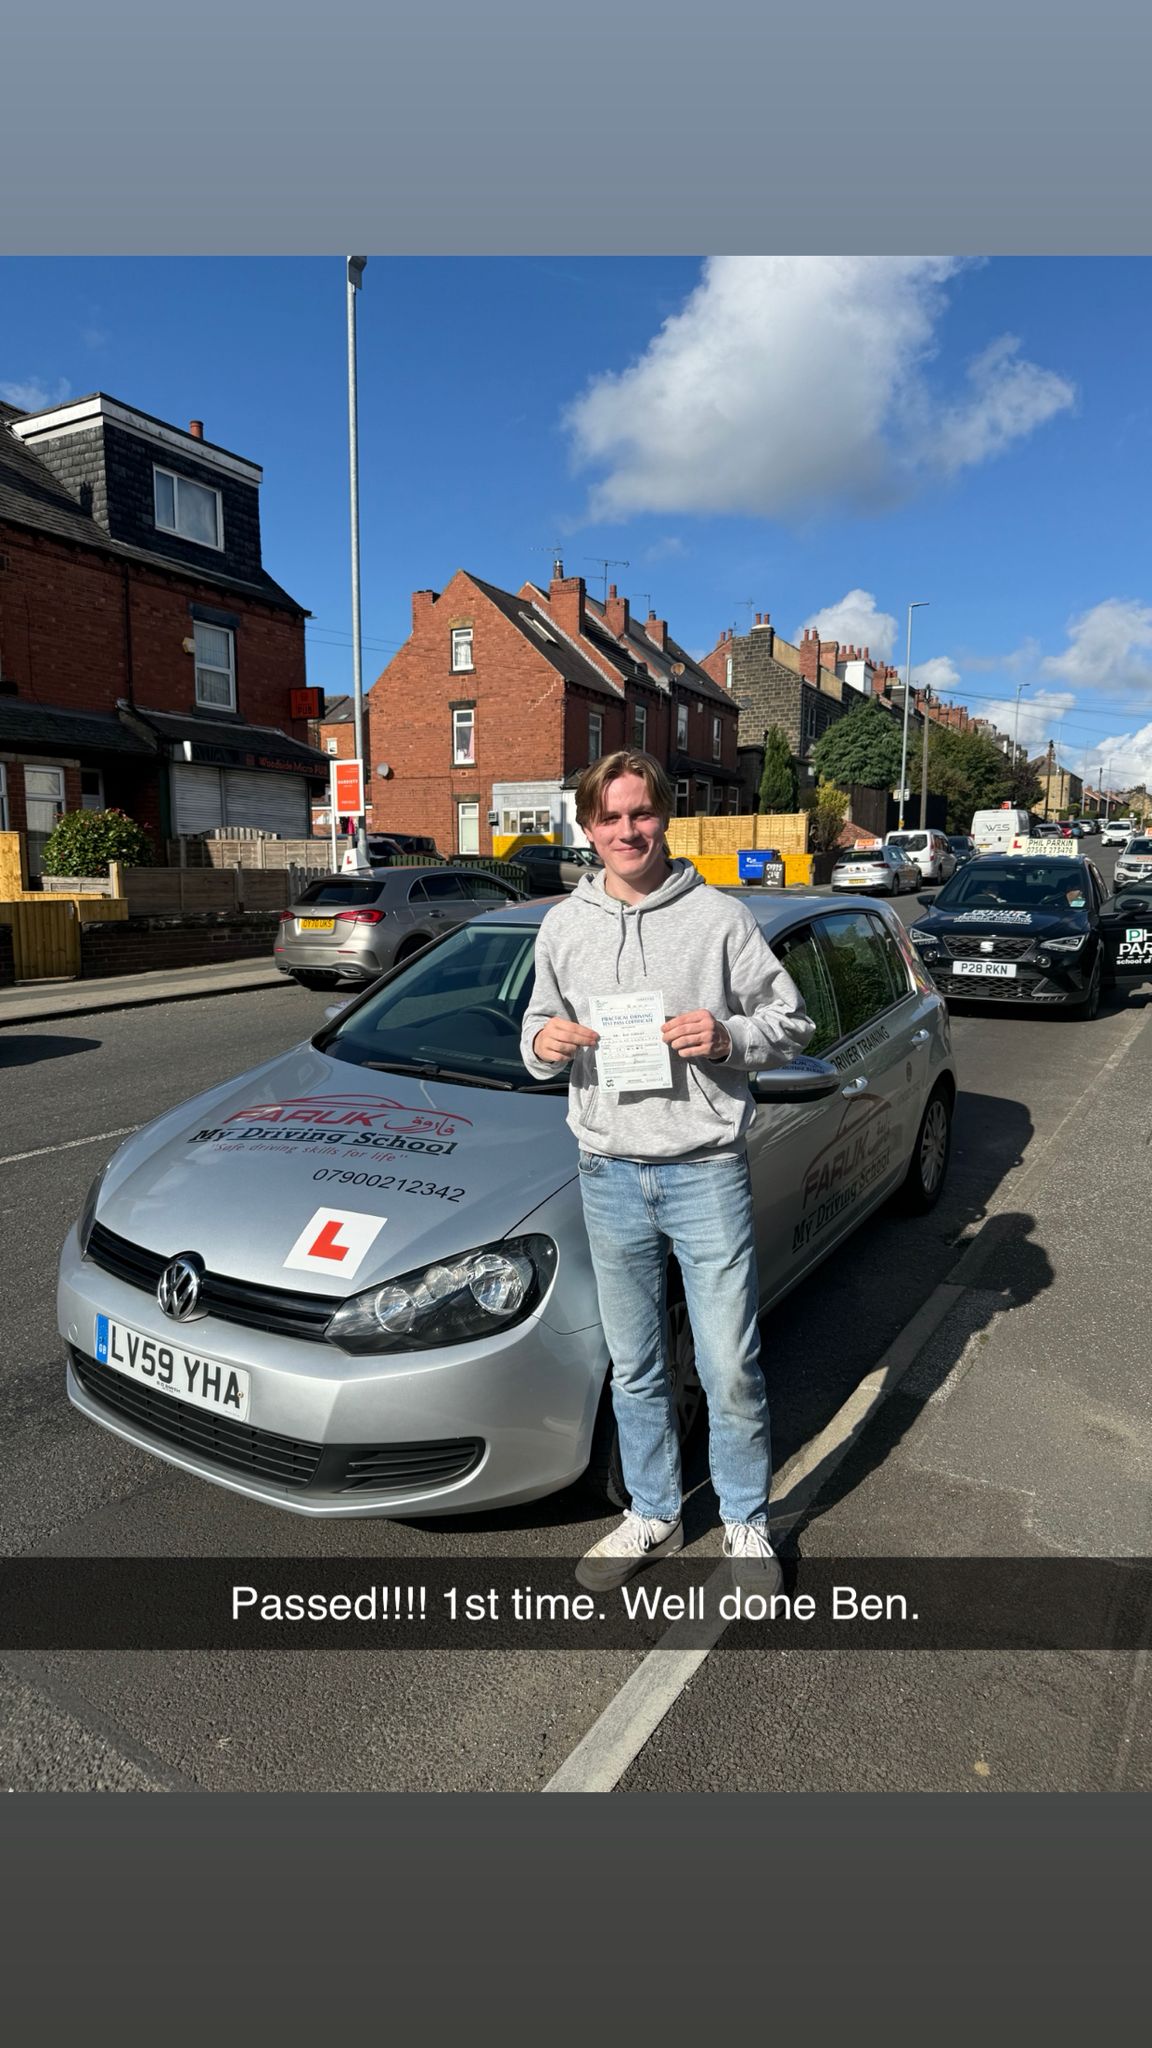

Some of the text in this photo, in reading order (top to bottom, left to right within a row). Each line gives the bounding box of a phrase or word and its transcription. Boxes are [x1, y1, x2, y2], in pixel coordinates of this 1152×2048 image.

[985, 824, 1010, 832] WES
[1013, 840, 1022, 849] L
[1028, 839, 1073, 847] PHIL PARKIN
[346, 856, 352, 865] L
[961, 963, 1008, 975] P28 RKN
[857, 1025, 890, 1056] TRAINING
[222, 1108, 389, 1127] FARUK
[189, 1127, 459, 1155] My Driving School
[249, 1142, 299, 1154] driving
[302, 1145, 340, 1156] skills
[342, 1148, 368, 1159] for
[312, 1167, 467, 1204] 07900212342
[792, 1145, 890, 1251] My Driving School
[307, 1220, 350, 1262] L
[111, 1325, 241, 1410] LV59 YHA
